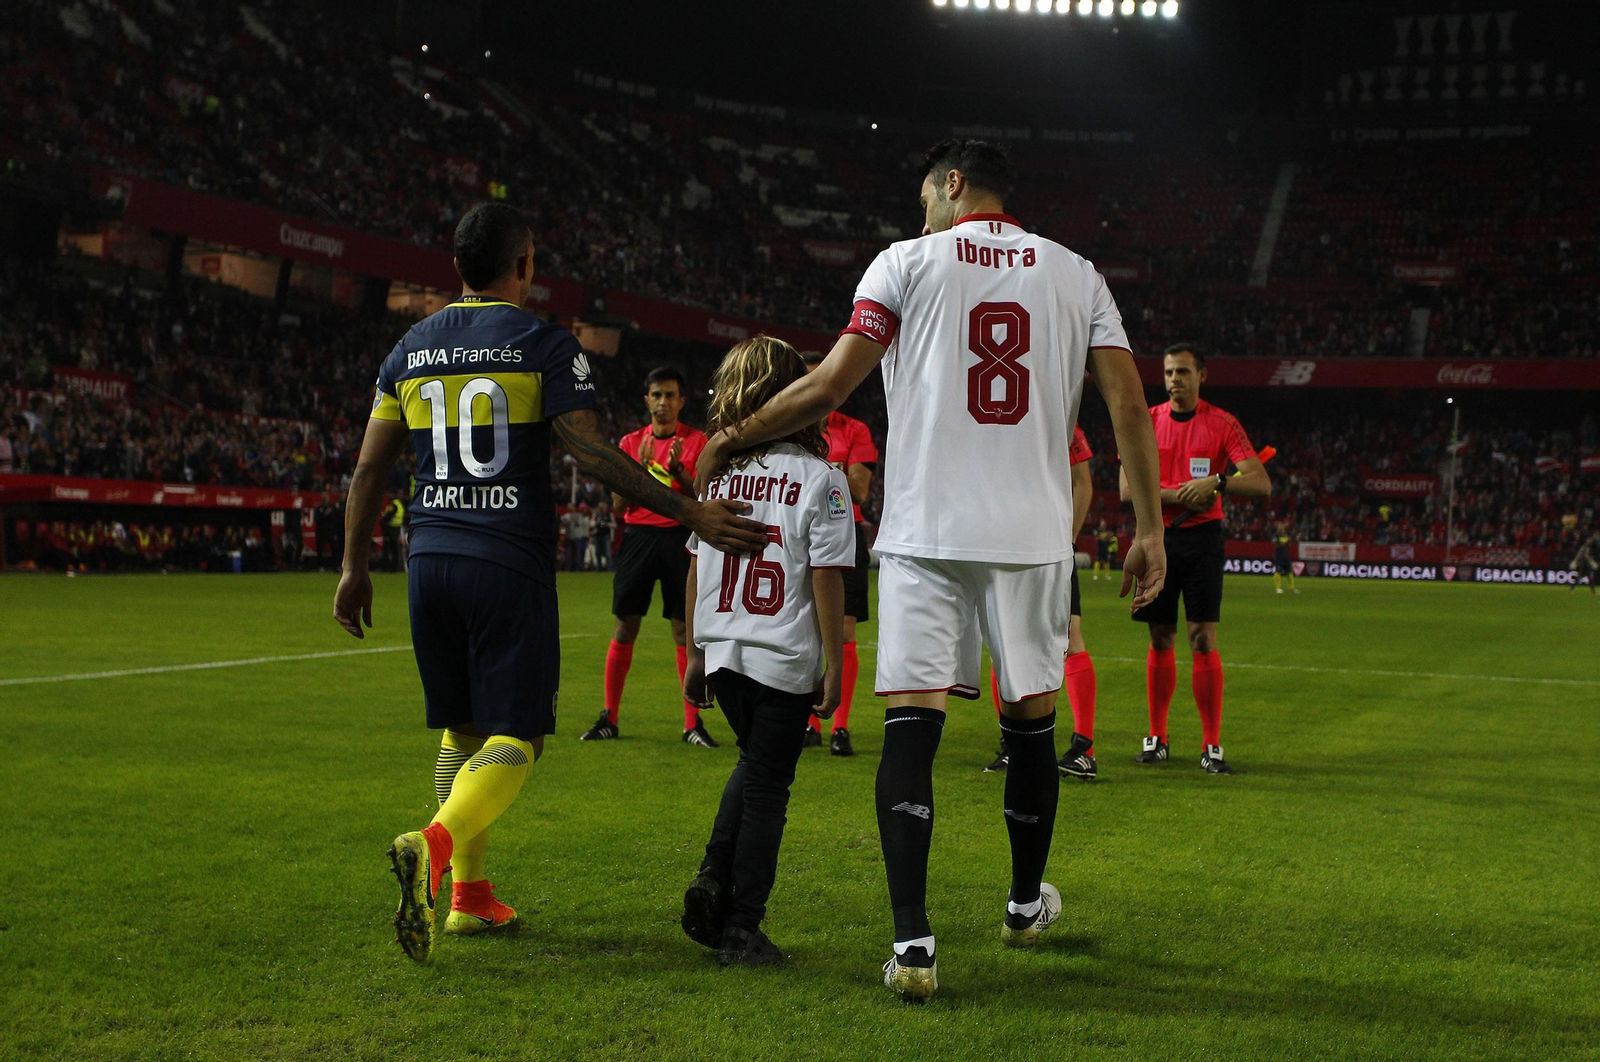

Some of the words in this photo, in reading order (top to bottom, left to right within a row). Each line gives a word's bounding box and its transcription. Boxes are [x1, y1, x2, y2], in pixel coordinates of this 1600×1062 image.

[956, 237, 1036, 269] iborra
[860, 309, 888, 326] SINCE
[860, 317, 886, 335] 1890
[407, 348, 449, 370] BBVA
[452, 344, 523, 364] Francés
[968, 302, 1031, 425] 8
[420, 378, 509, 480] 10
[422, 485, 519, 509] CARLITOS
[729, 473, 802, 506] puerta
[1364, 479, 1436, 491] CORDIALITY
[715, 525, 786, 616] 16
[1243, 560, 1277, 573] BOC
[1391, 565, 1436, 580] BOCA!
